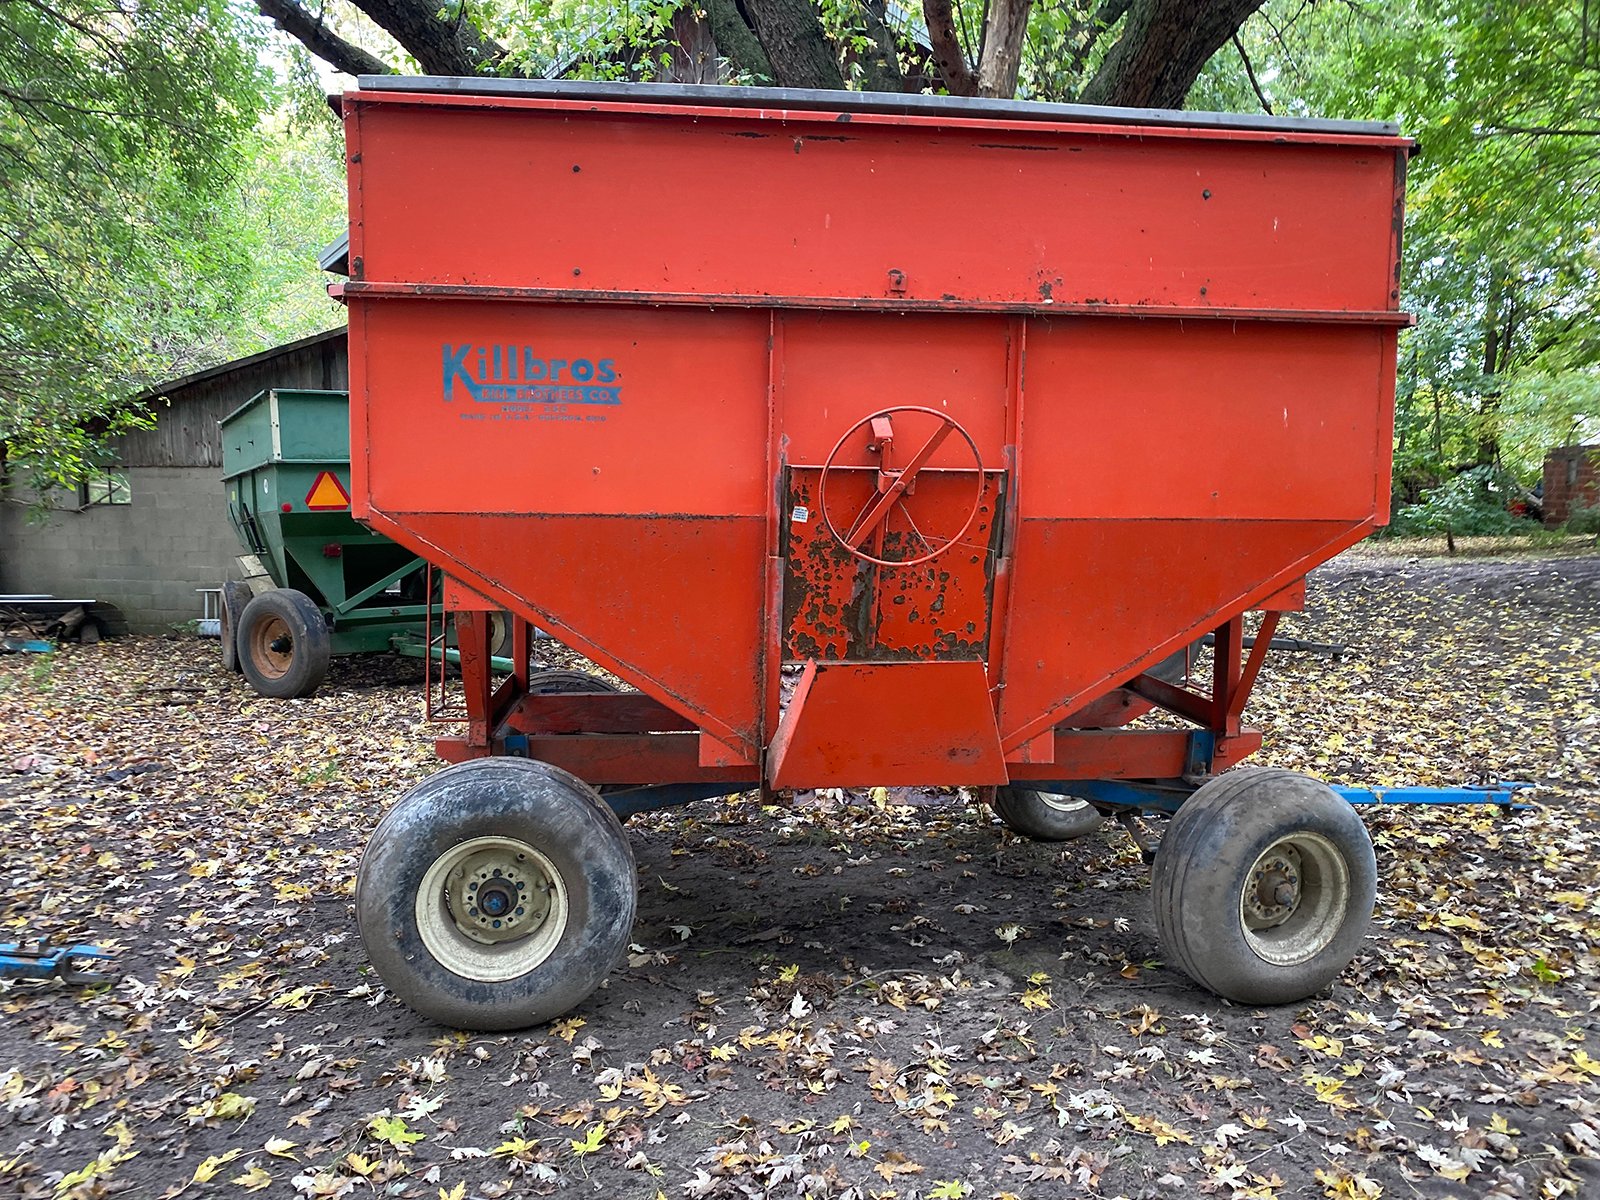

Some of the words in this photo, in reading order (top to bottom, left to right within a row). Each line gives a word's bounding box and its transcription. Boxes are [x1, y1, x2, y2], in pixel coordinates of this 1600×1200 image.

[441, 343, 617, 401] Killbros
[482, 388, 509, 399] KILL
[516, 389, 583, 401] BROTHERS
[589, 390, 613, 401] CO.
